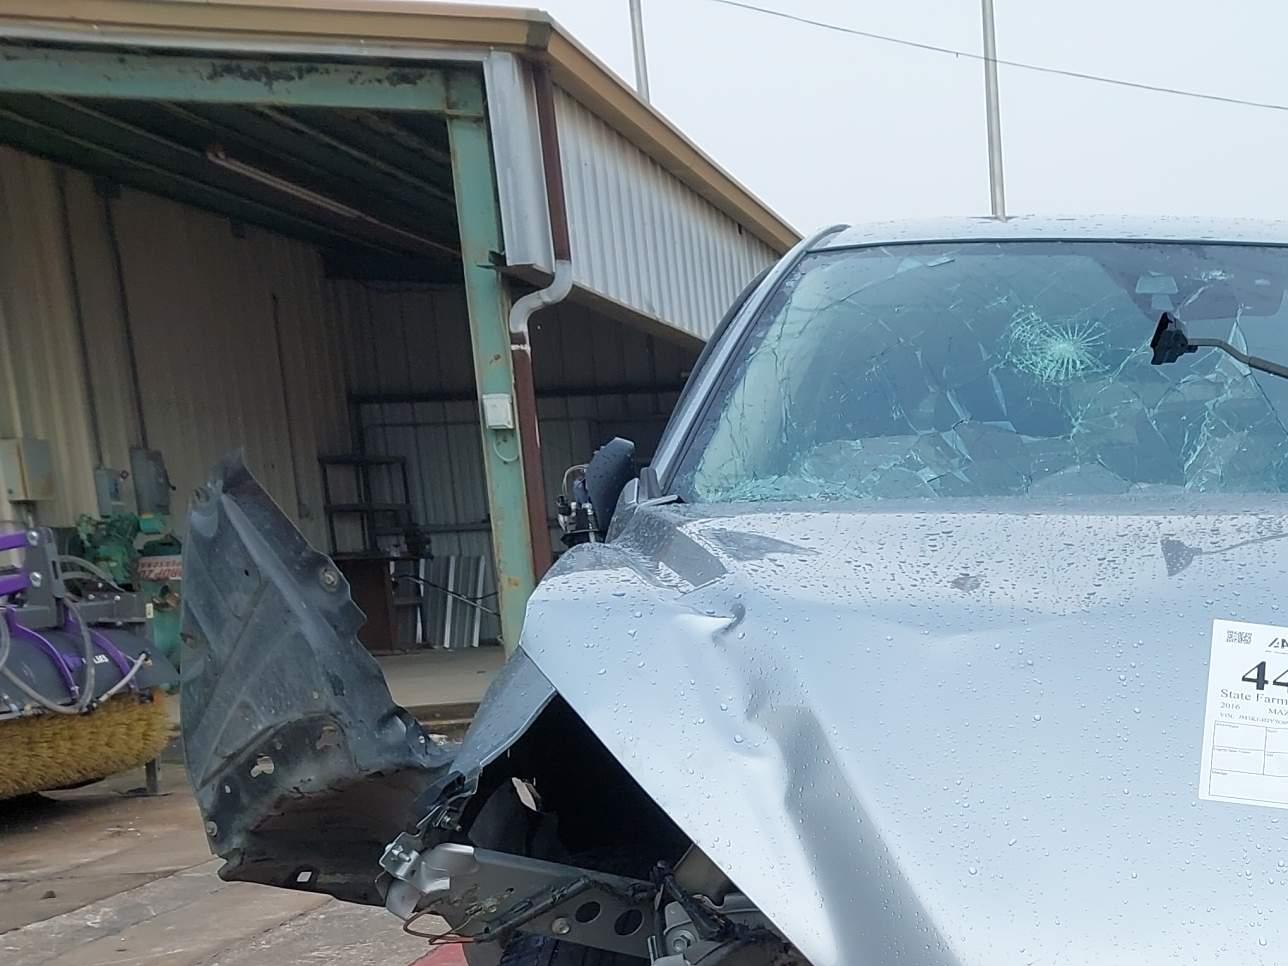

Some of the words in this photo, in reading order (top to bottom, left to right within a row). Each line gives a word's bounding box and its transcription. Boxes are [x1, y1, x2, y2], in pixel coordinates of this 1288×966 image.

[1220, 688, 1252, 701] State
[1256, 692, 1288, 706] Farm
[1220, 702, 1241, 710] 2016
